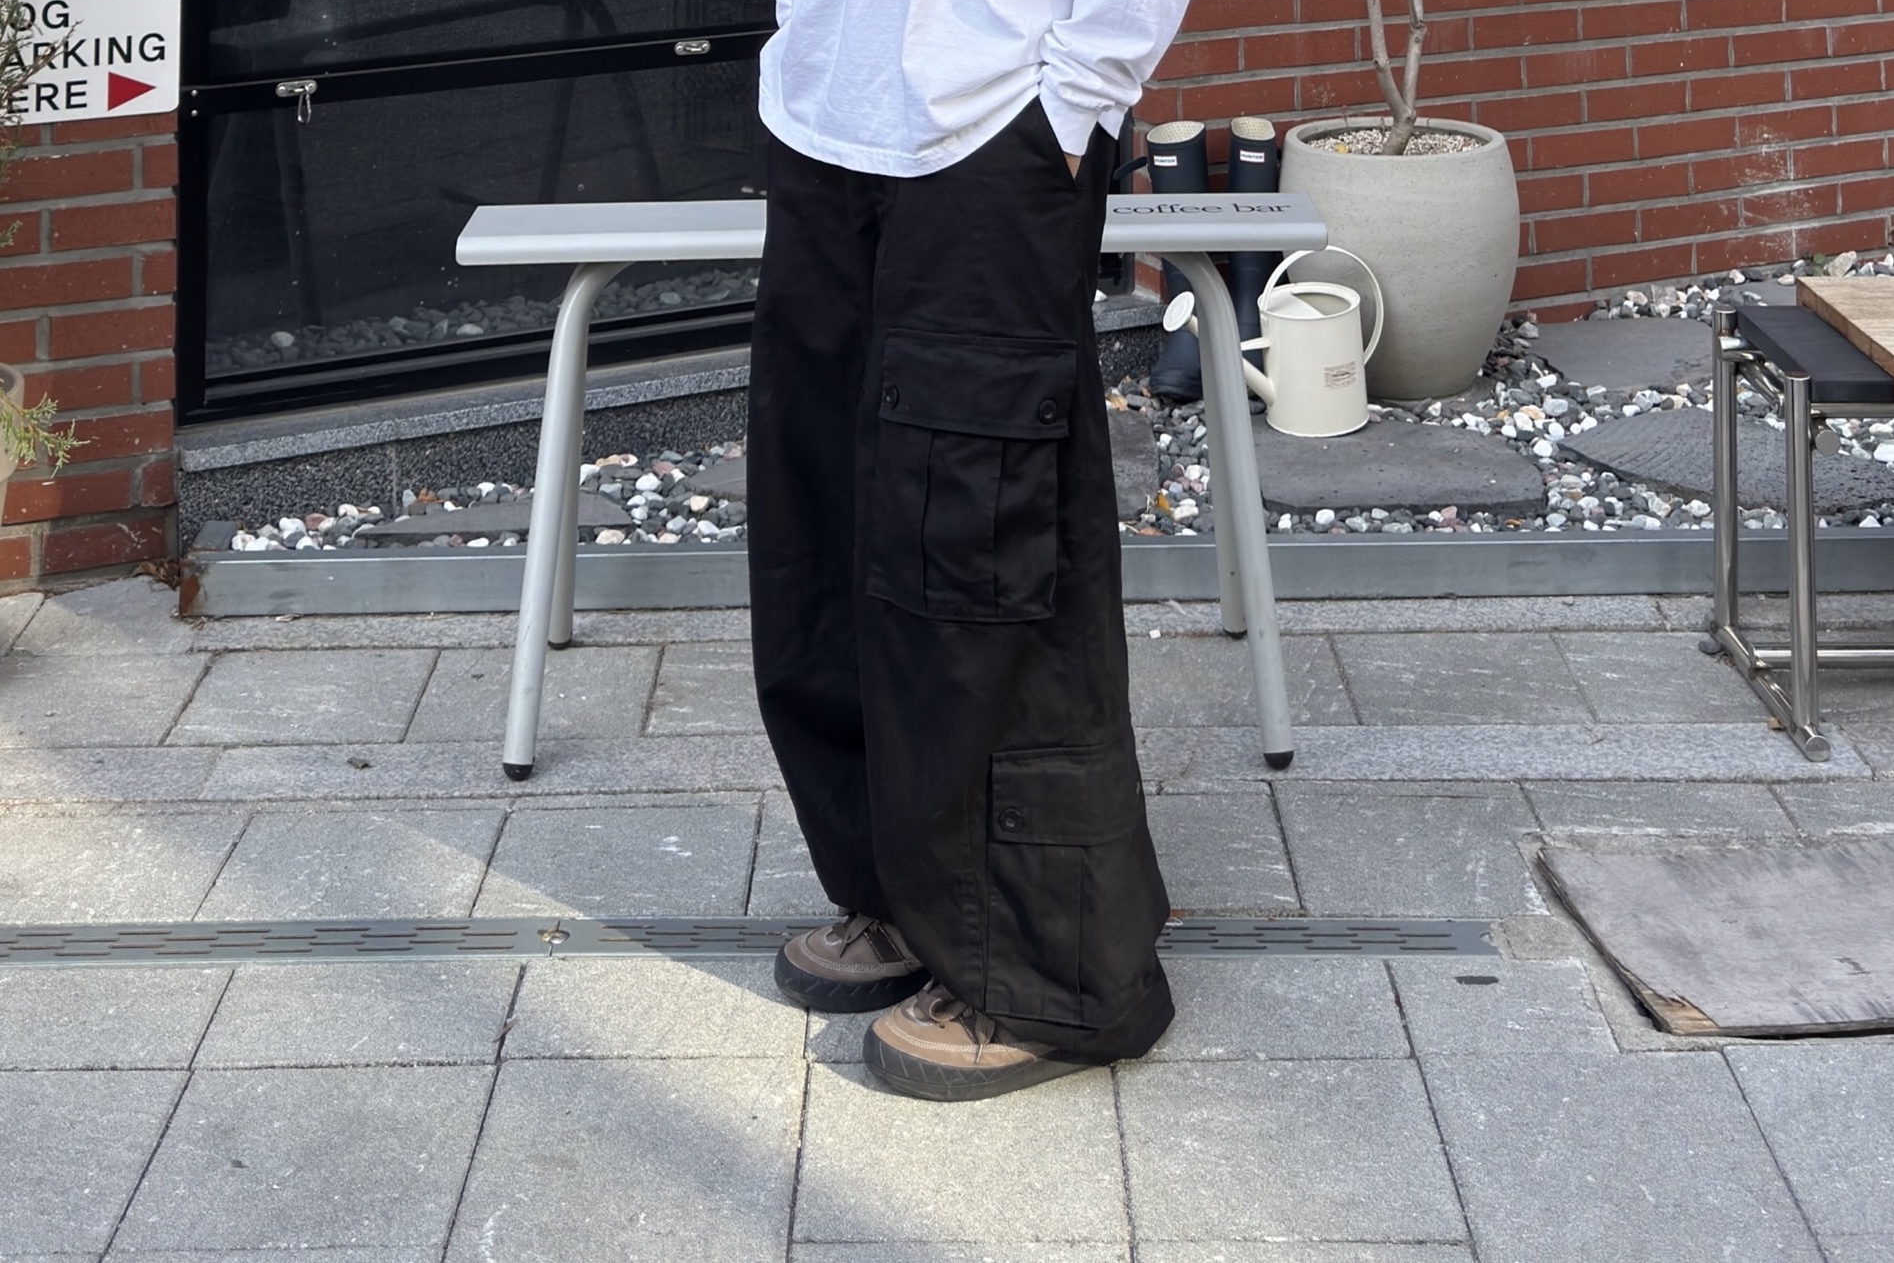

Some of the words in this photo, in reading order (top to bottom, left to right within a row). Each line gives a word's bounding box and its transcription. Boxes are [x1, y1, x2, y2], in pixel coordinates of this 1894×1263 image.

[9, 0, 70, 31] OG
[3, 32, 166, 72] ARKING
[7, 80, 88, 115] ERE
[1113, 203, 1222, 215] coffee
[1232, 203, 1291, 214] bar
